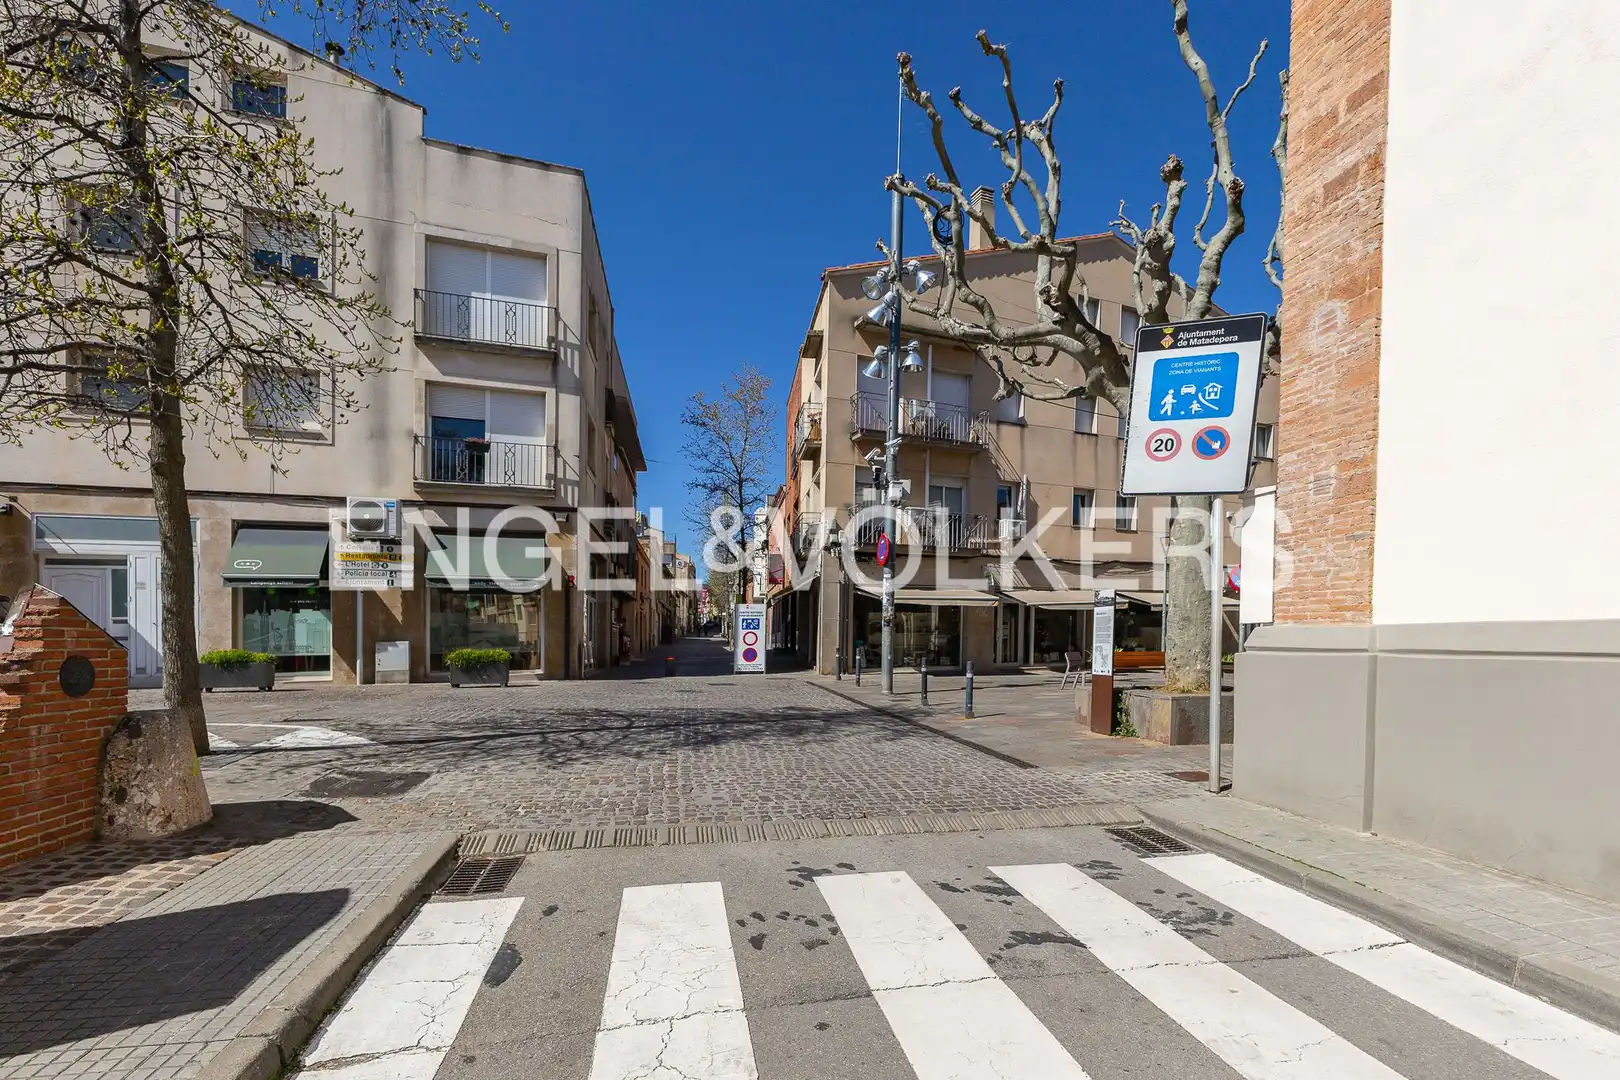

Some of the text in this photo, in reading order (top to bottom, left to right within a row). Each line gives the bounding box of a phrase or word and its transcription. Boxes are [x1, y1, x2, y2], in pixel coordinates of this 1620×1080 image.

[1178, 328, 1225, 340] Ajuntament
[1189, 335, 1238, 347] Matadepera
[1153, 438, 1175, 453] 20
